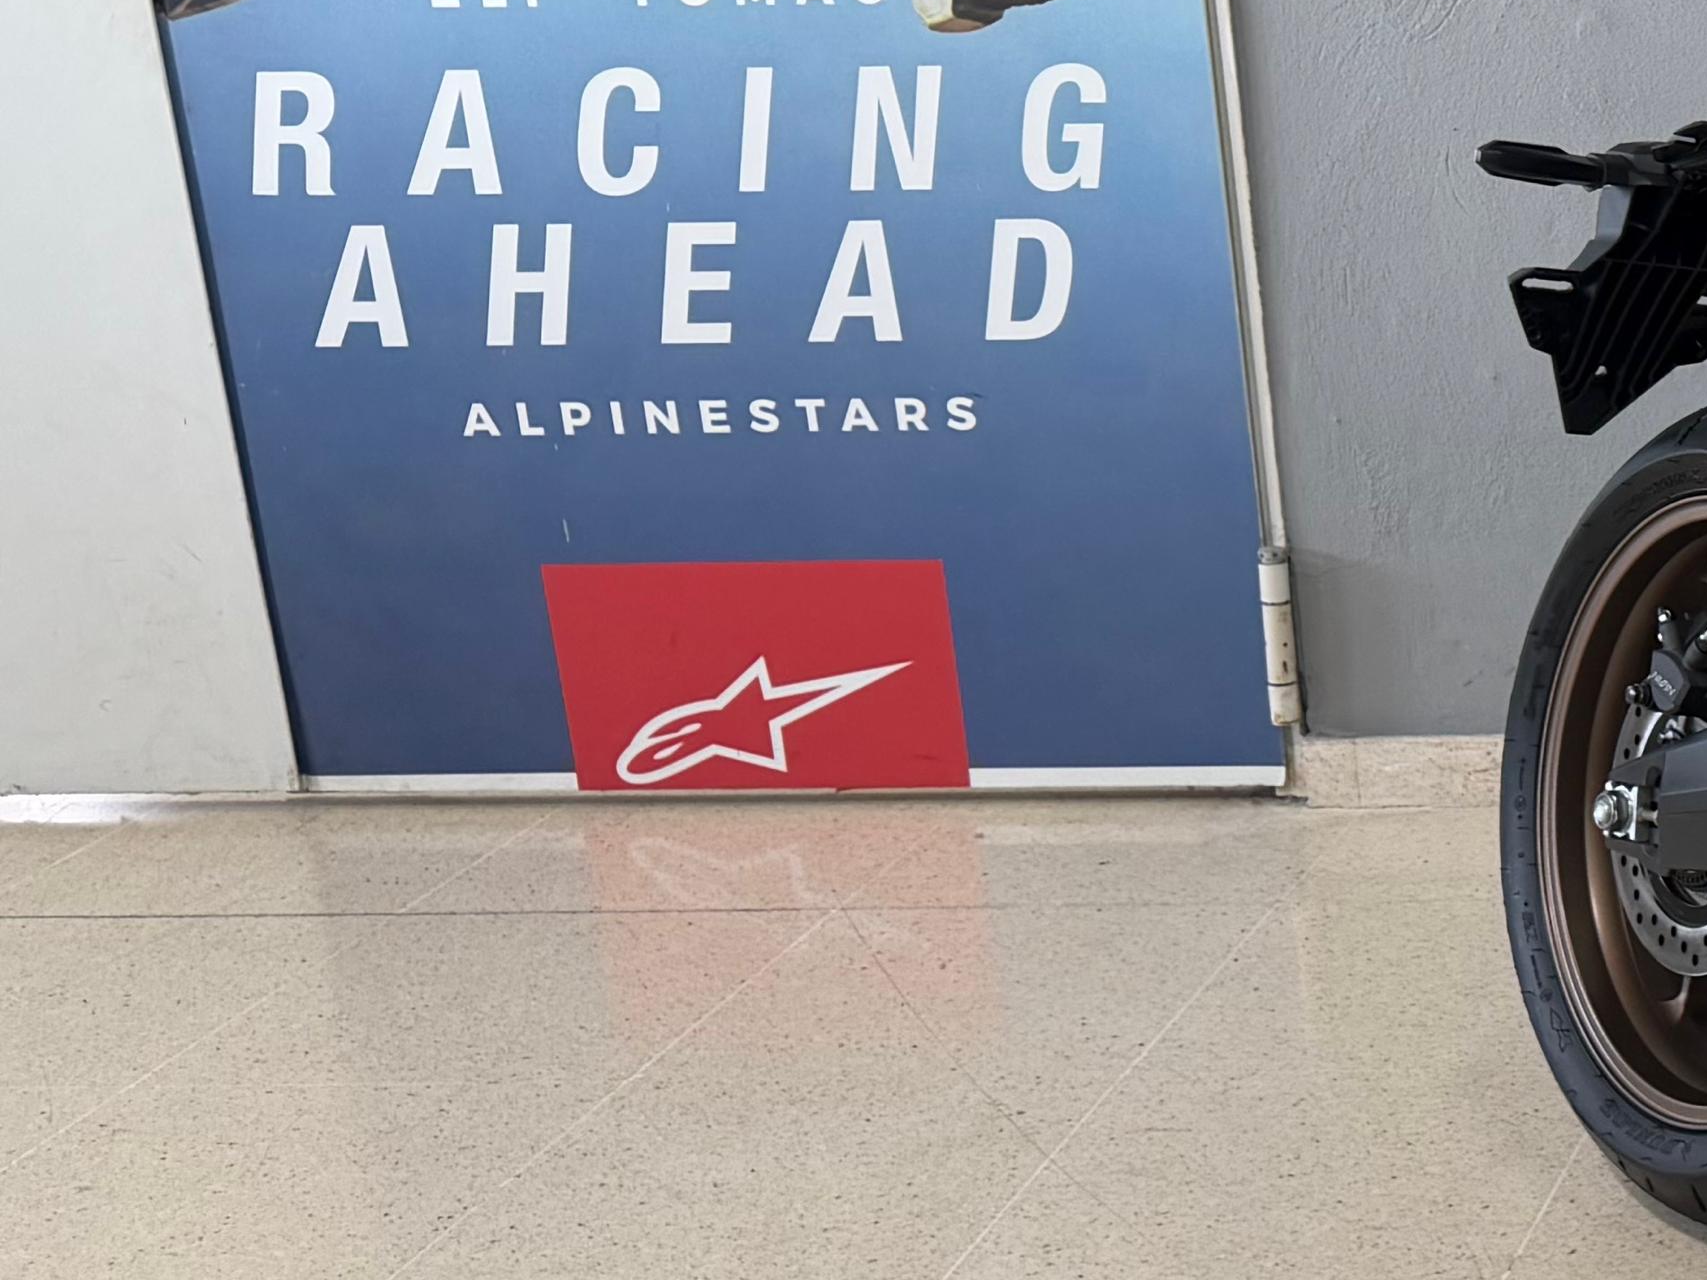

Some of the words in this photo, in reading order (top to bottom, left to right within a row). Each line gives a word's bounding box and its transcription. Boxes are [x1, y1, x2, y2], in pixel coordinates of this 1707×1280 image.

[252, 62, 1107, 197] RACING
[315, 218, 1074, 348] AHEAD
[462, 396, 979, 438] ALPINESTARS
